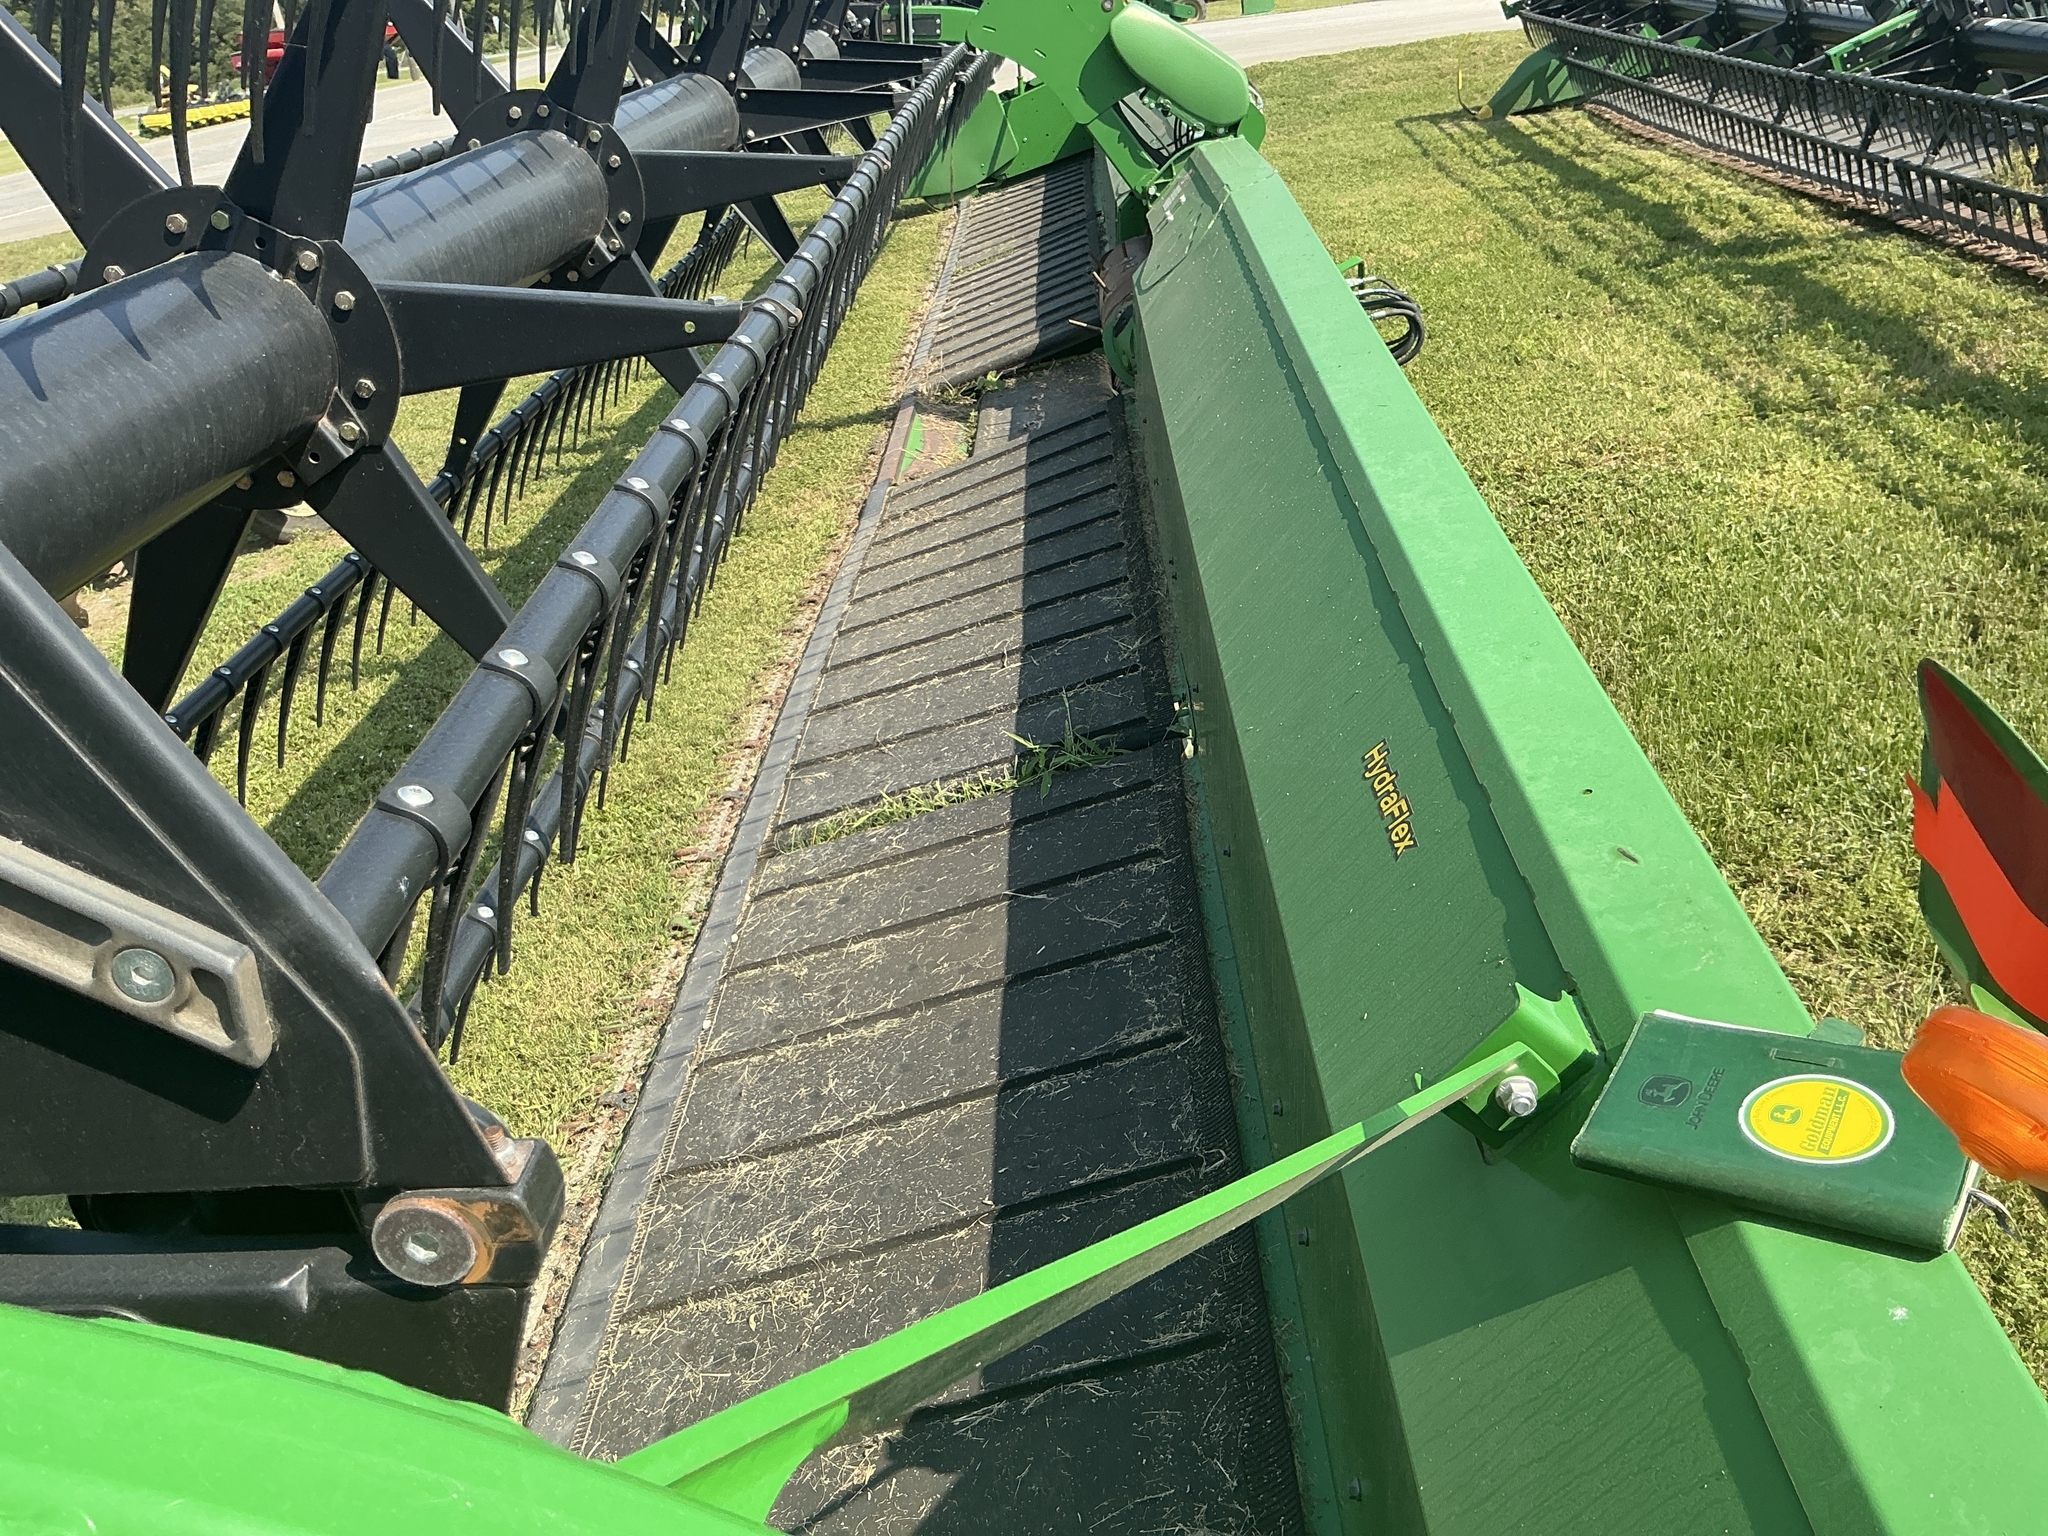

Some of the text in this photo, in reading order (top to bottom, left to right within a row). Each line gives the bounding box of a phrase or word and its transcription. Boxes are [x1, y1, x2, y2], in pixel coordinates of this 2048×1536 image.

[1363, 741, 1415, 857] HydraFlex
[1685, 1067, 1726, 1131] JOHN DEERE
[1798, 1086, 1838, 1152] Goldman
[1820, 1111, 1841, 1151] EQUIPMENT
